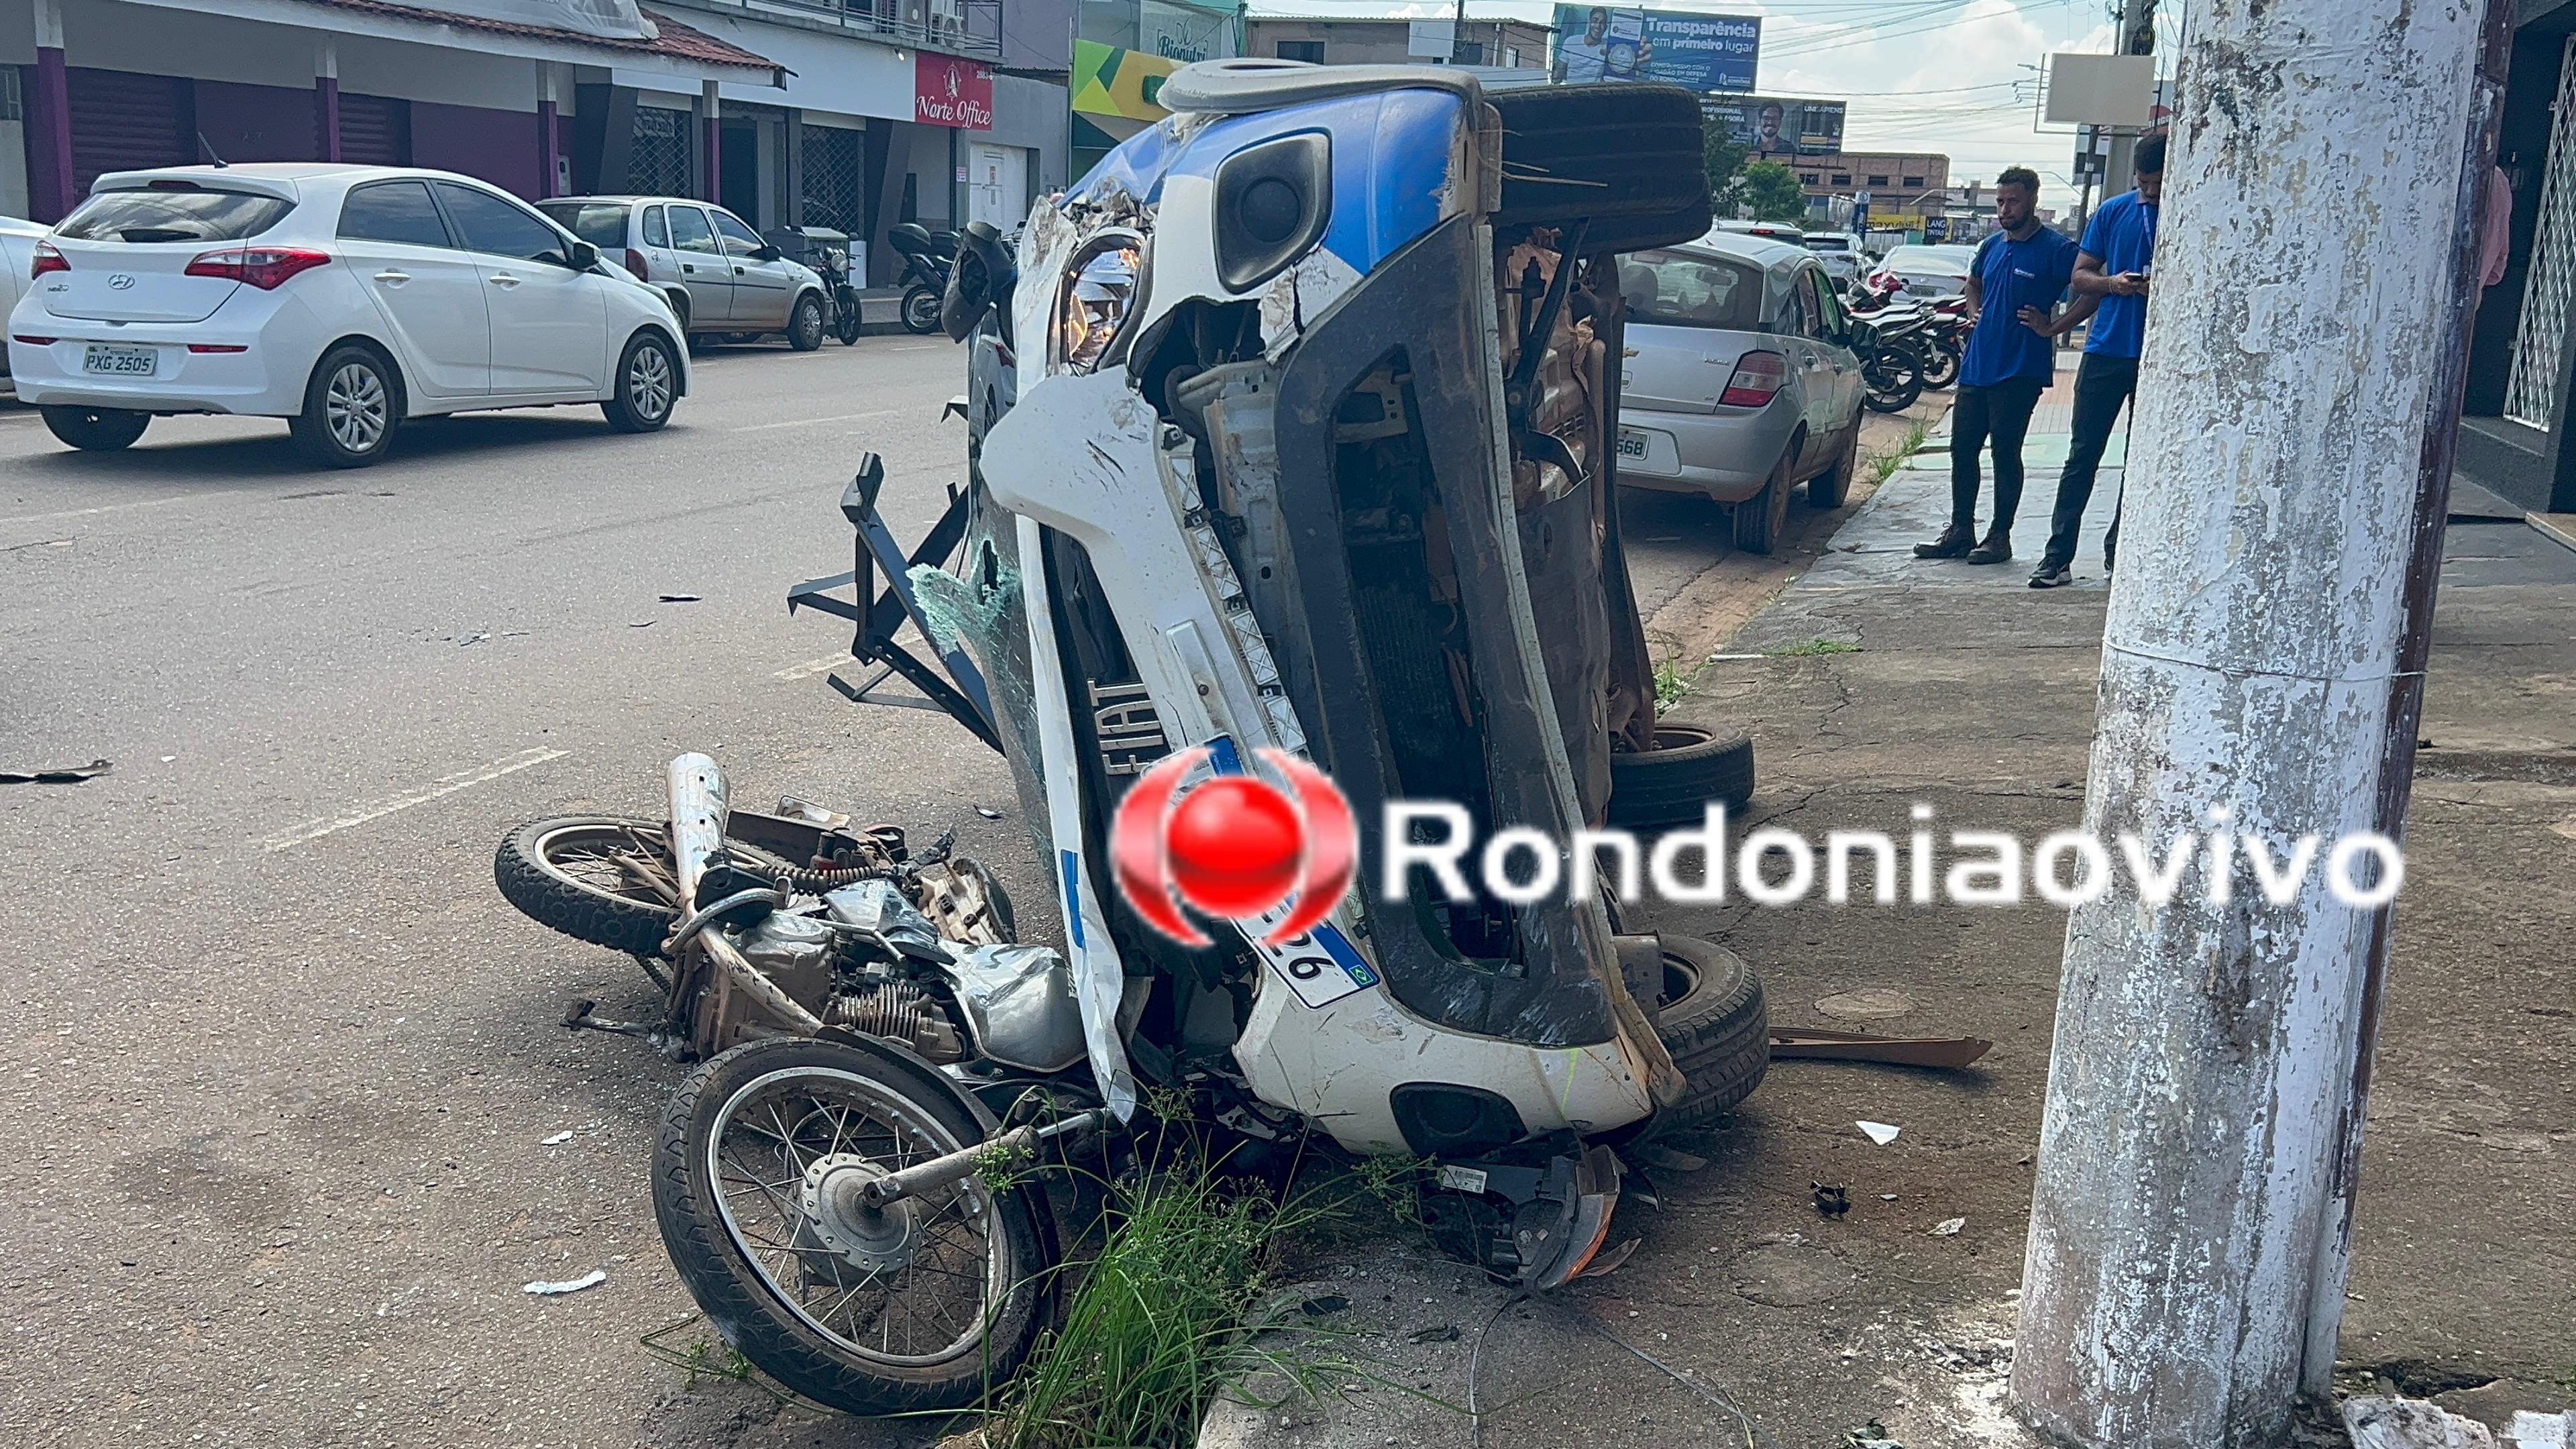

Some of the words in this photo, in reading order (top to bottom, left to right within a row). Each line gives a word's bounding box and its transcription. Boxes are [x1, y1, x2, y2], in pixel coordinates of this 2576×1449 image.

[1646, 17, 1756, 38] Transparência
[1159, 36, 1205, 63] Bionutri
[1672, 38, 1723, 50] primeiro
[1725, 40, 1754, 54] lugar
[916, 95, 953, 121] Norte
[957, 100, 992, 128] Office
[1927, 220, 1945, 228] LANG
[86, 356, 113, 370] PXG
[115, 357, 152, 372] 2505
[1087, 680, 1164, 775] FIAT
